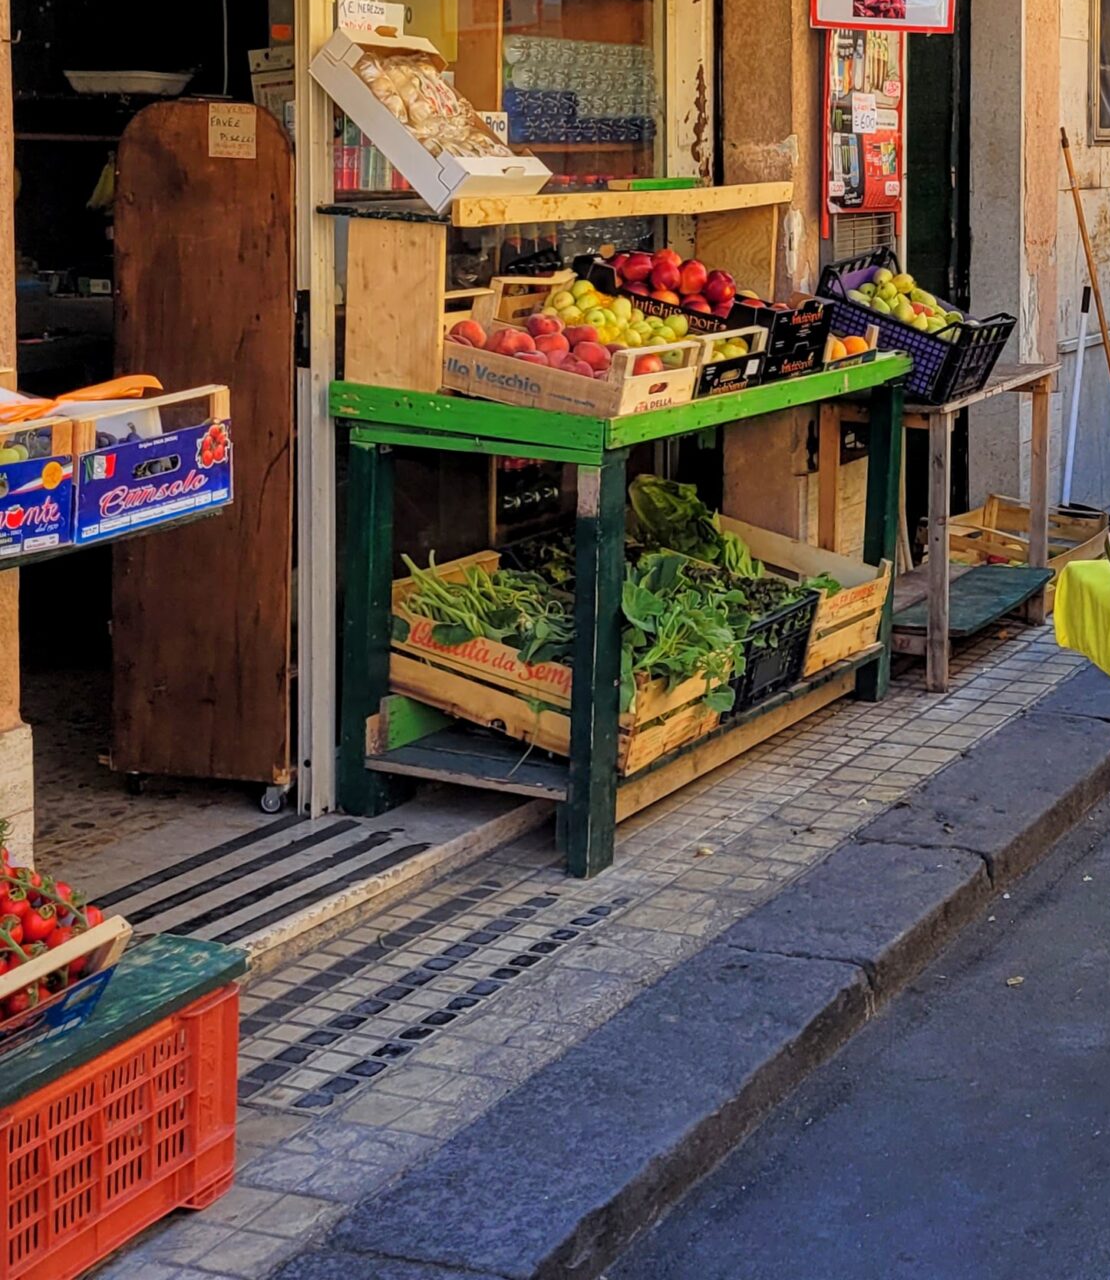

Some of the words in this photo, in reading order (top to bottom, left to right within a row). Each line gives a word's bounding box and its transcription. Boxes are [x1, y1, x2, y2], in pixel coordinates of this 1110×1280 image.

[475, 363, 542, 393] Vecchia
[650, 397, 672, 409] DELLA
[491, 652, 515, 672] da
